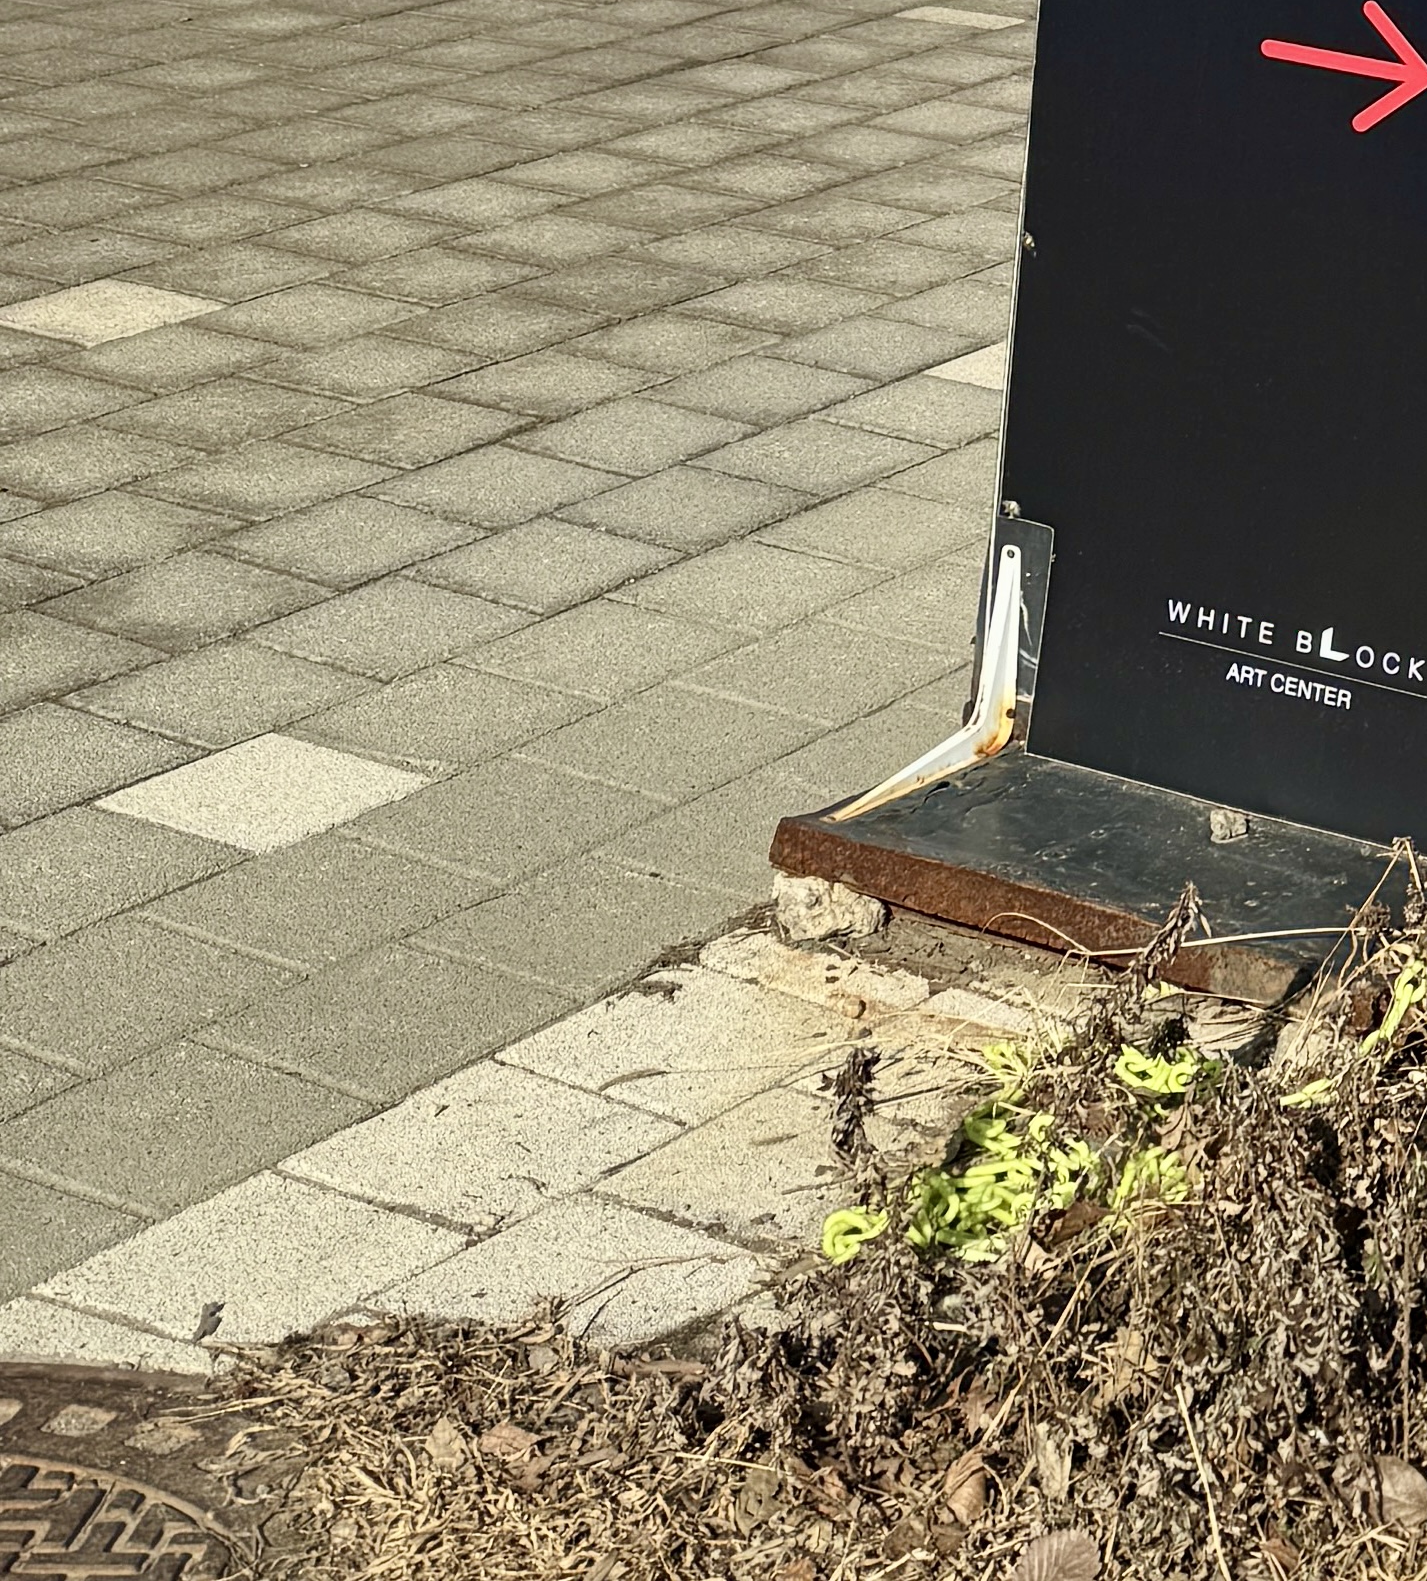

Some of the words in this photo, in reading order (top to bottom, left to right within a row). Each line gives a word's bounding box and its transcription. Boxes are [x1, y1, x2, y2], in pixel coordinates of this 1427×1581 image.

[1168, 599, 1276, 646] WHITE
[1295, 626, 1427, 682] BLOCK
[1226, 662, 1268, 688] ART
[1270, 672, 1352, 710] CENTER
